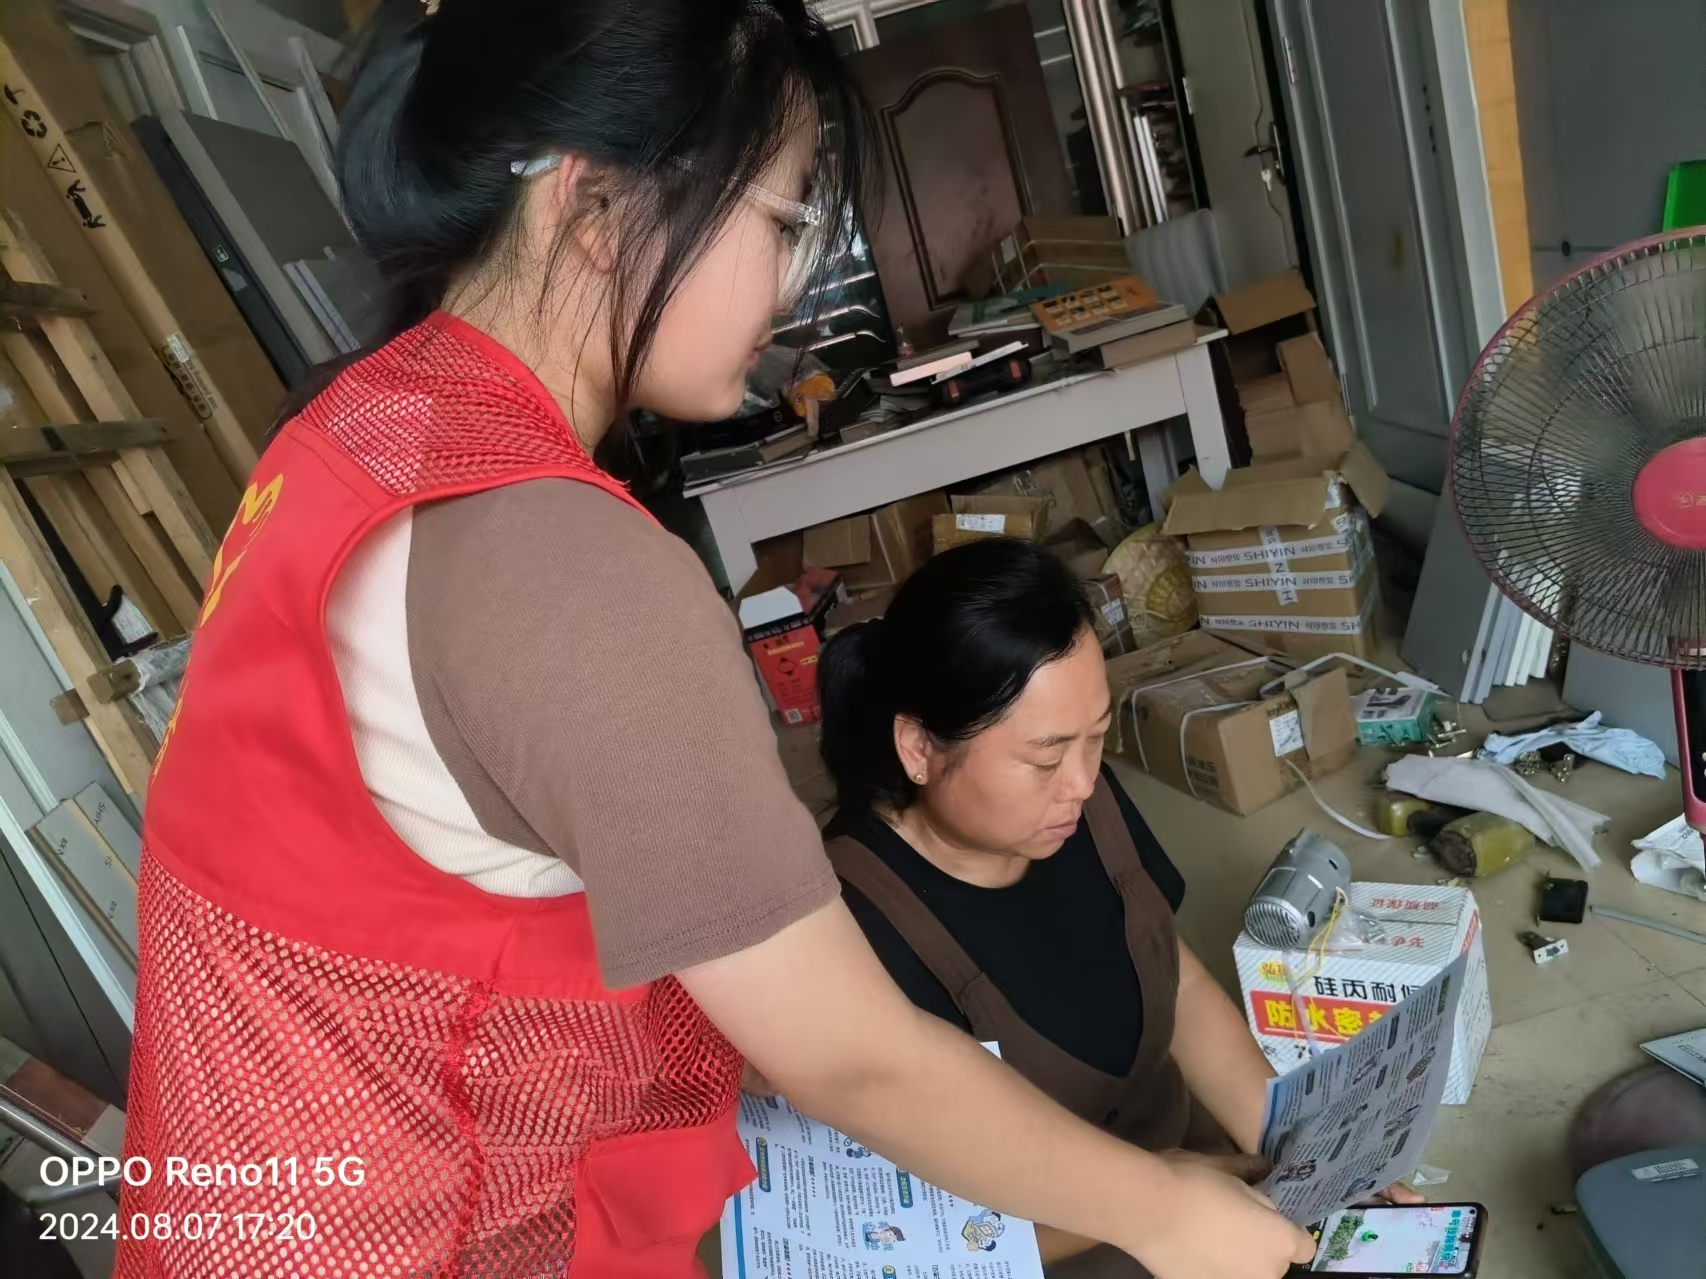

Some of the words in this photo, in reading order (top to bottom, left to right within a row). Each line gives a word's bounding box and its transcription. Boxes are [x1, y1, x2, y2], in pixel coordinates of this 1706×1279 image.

[1243, 546, 1296, 561] SHIYIN
[1244, 577, 1297, 588] SHIYIN
[1249, 619, 1300, 630] SHIYIN
